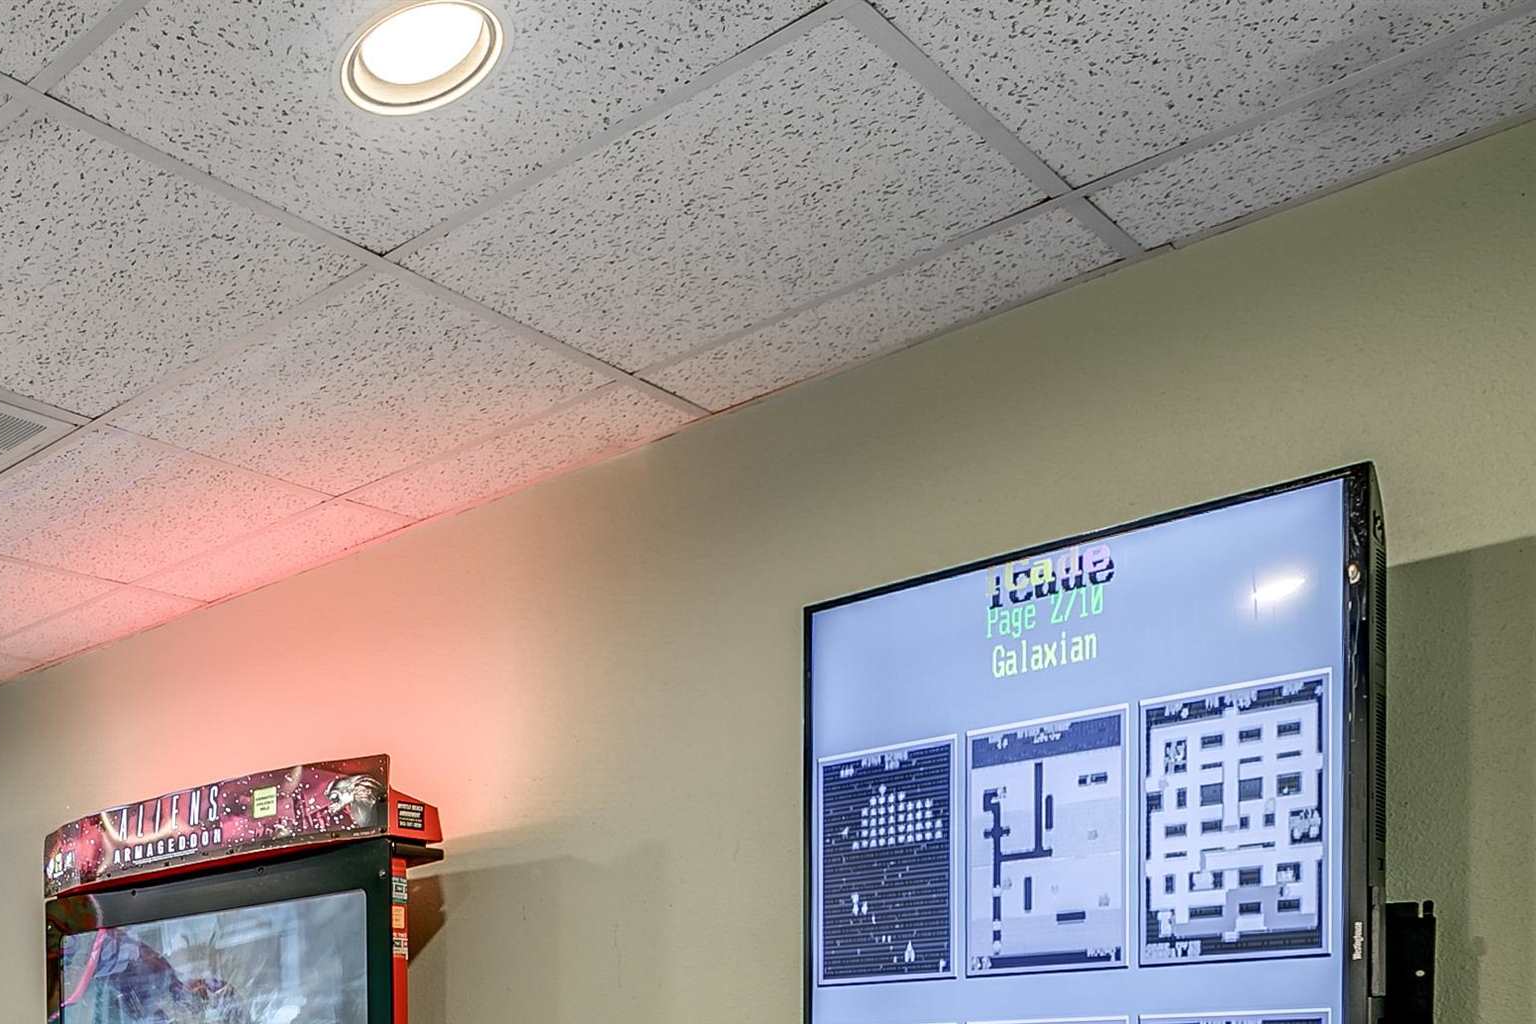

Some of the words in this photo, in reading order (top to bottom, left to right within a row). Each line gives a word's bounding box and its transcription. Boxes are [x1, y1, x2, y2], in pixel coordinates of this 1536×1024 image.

[986, 603, 1036, 639] Page
[1050, 584, 1104, 625] 2/10
[992, 632, 1097, 679] Galaxian
[119, 785, 220, 842] ALIENS
[114, 828, 222, 865] ARMAGEDDON
